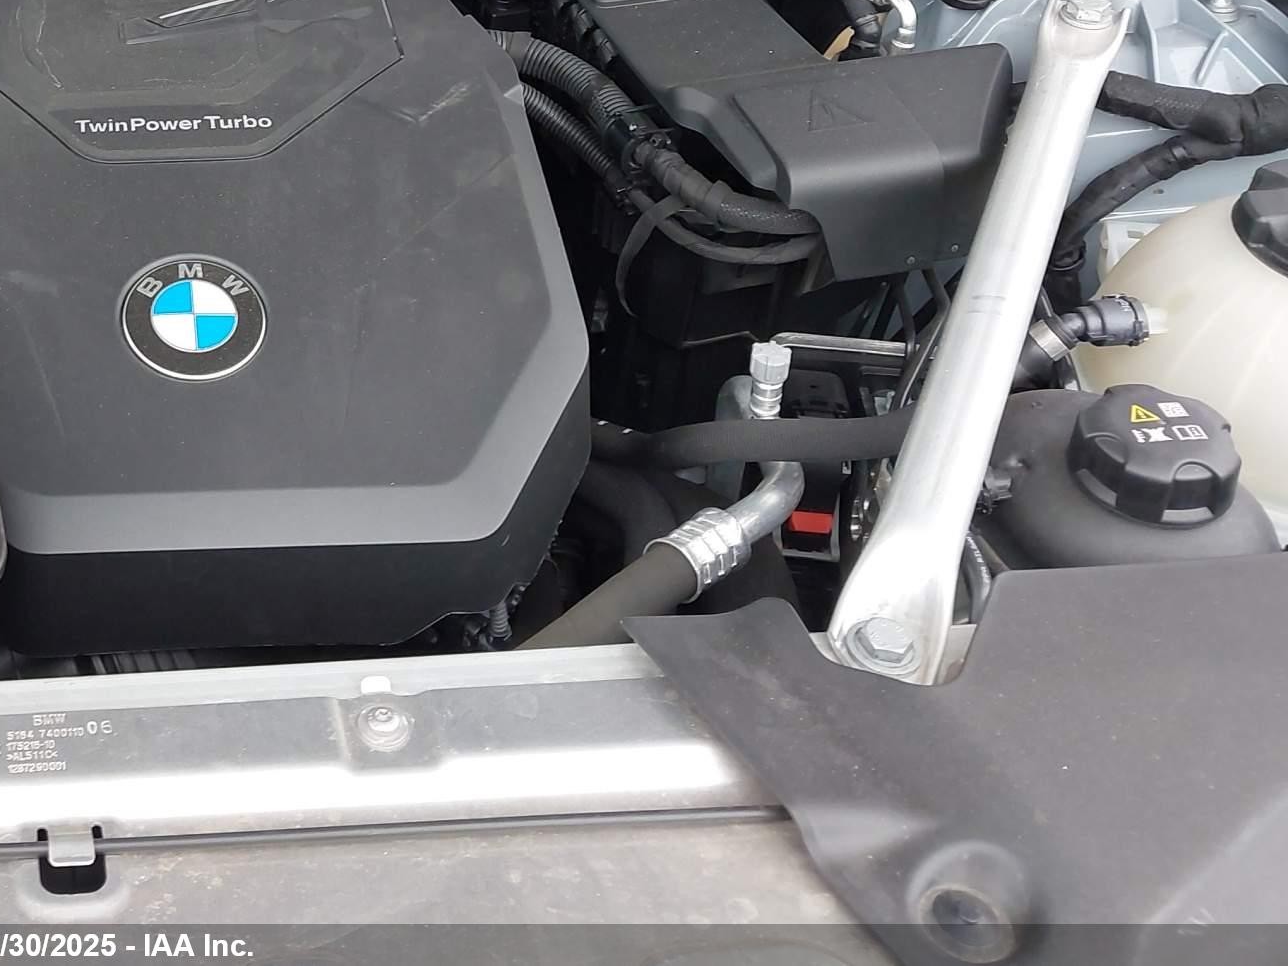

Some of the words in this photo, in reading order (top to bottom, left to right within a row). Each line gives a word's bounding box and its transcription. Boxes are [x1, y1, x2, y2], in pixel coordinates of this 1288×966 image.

[204, 114, 272, 130] Turbo
[136, 263, 250, 298] BMW
[32, 713, 66, 726] BMW
